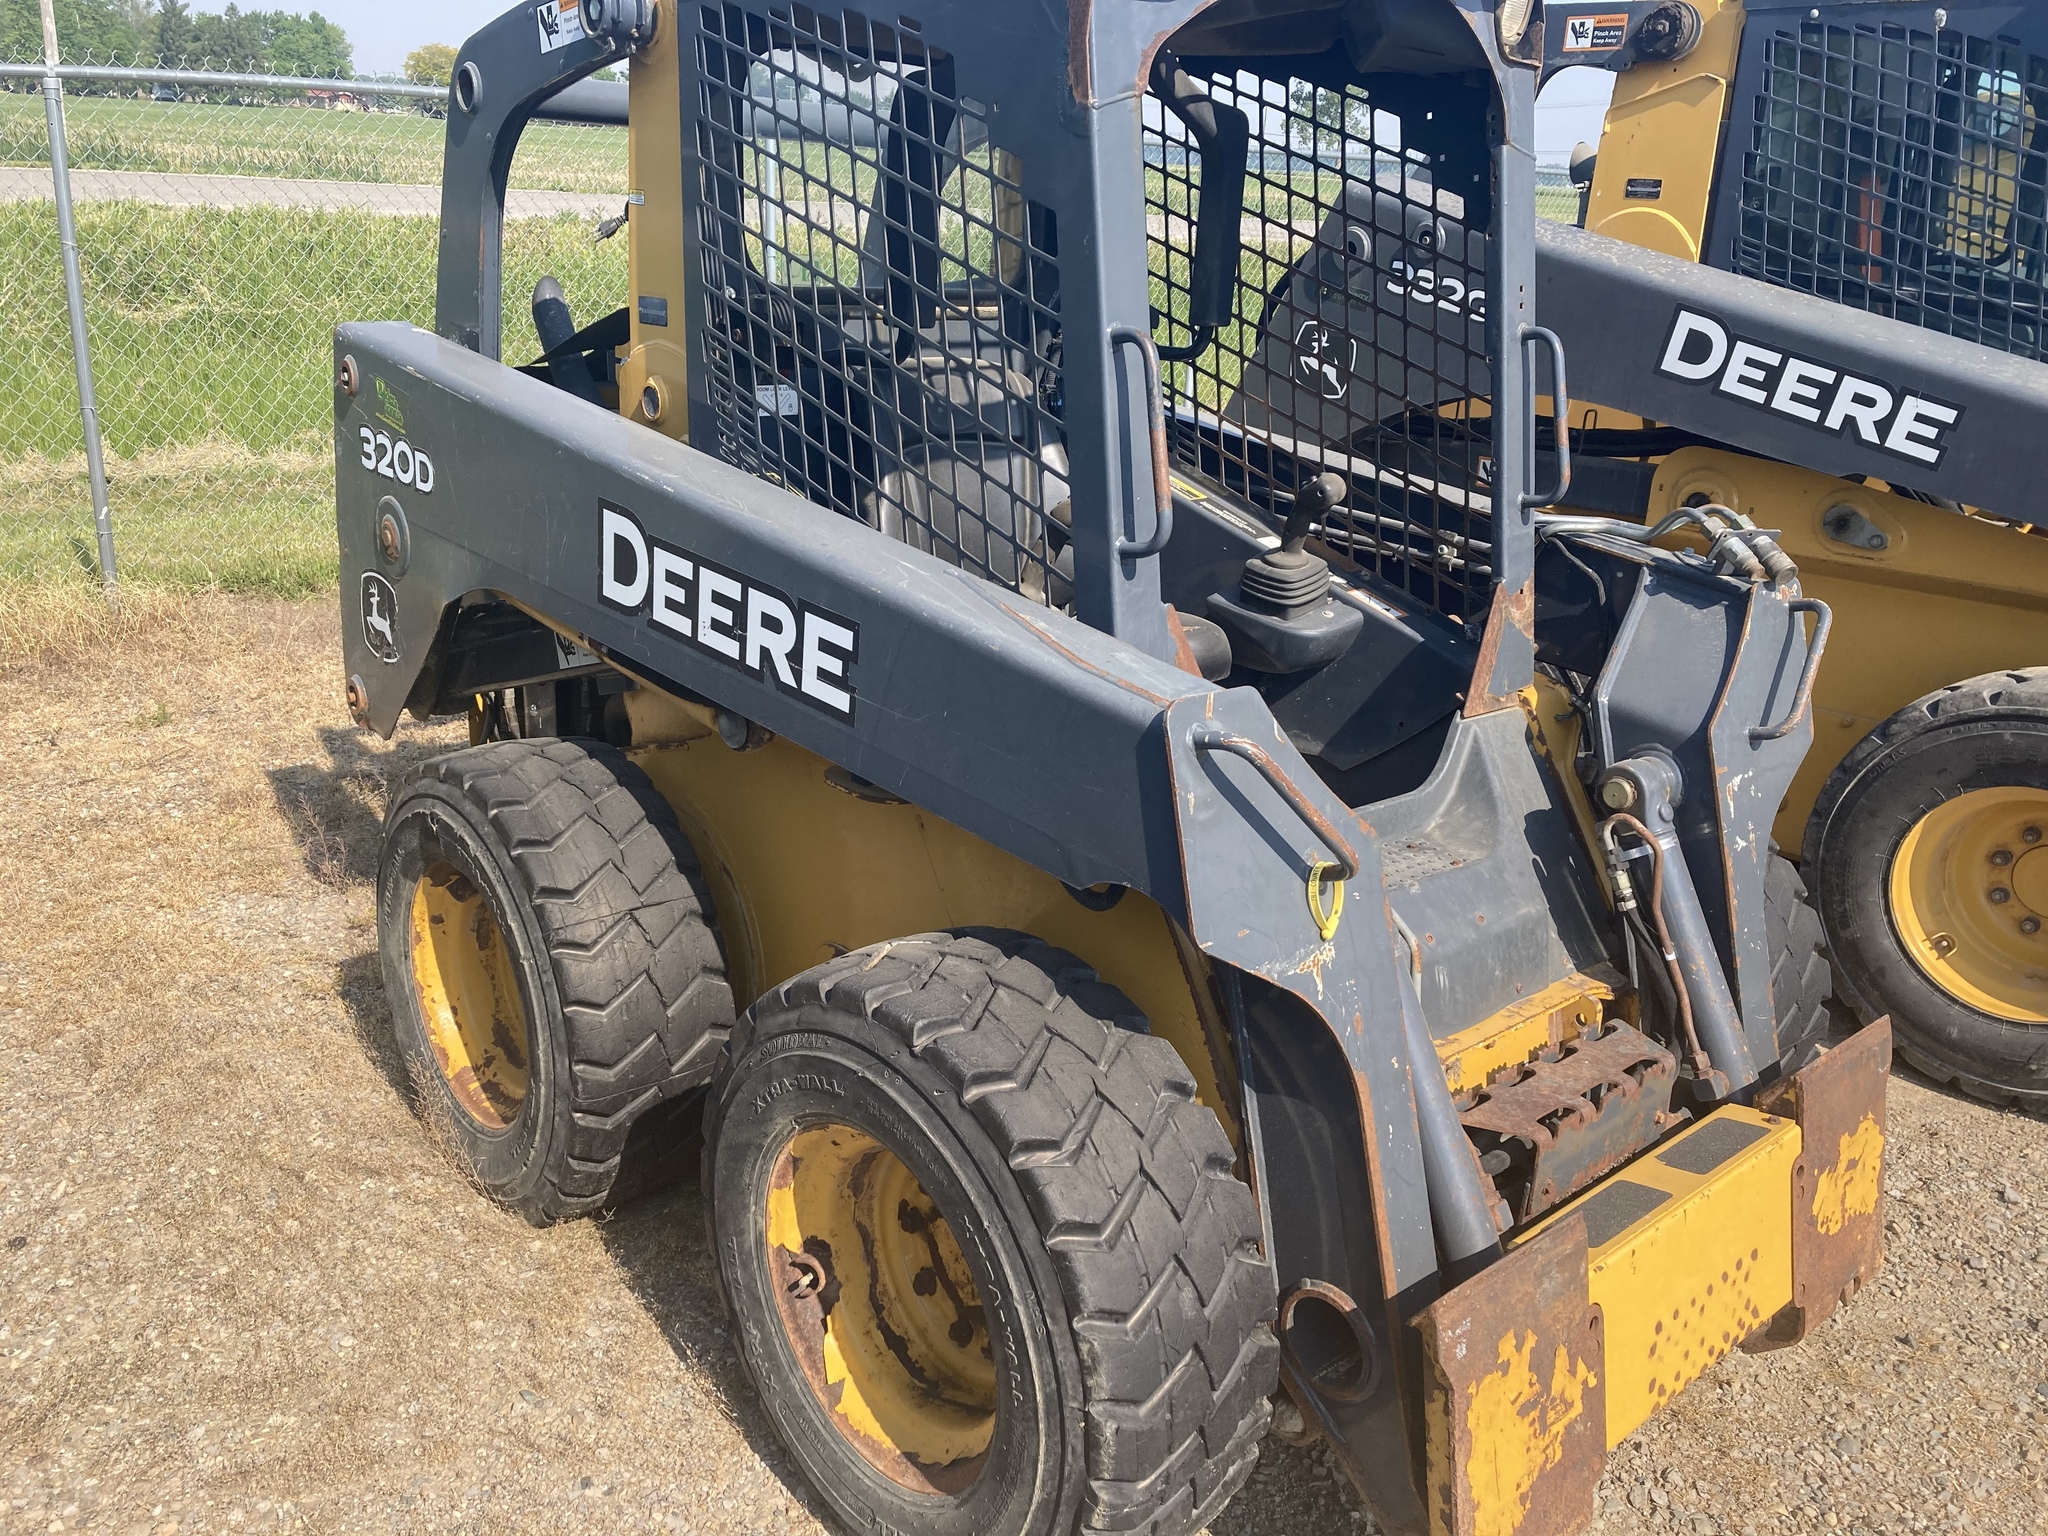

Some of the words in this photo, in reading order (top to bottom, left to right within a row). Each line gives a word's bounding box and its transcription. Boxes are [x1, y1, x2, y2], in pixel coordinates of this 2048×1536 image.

[359, 426, 434, 493] 320D
[1659, 308, 1959, 464] DEERE
[602, 507, 854, 714] DEERE
